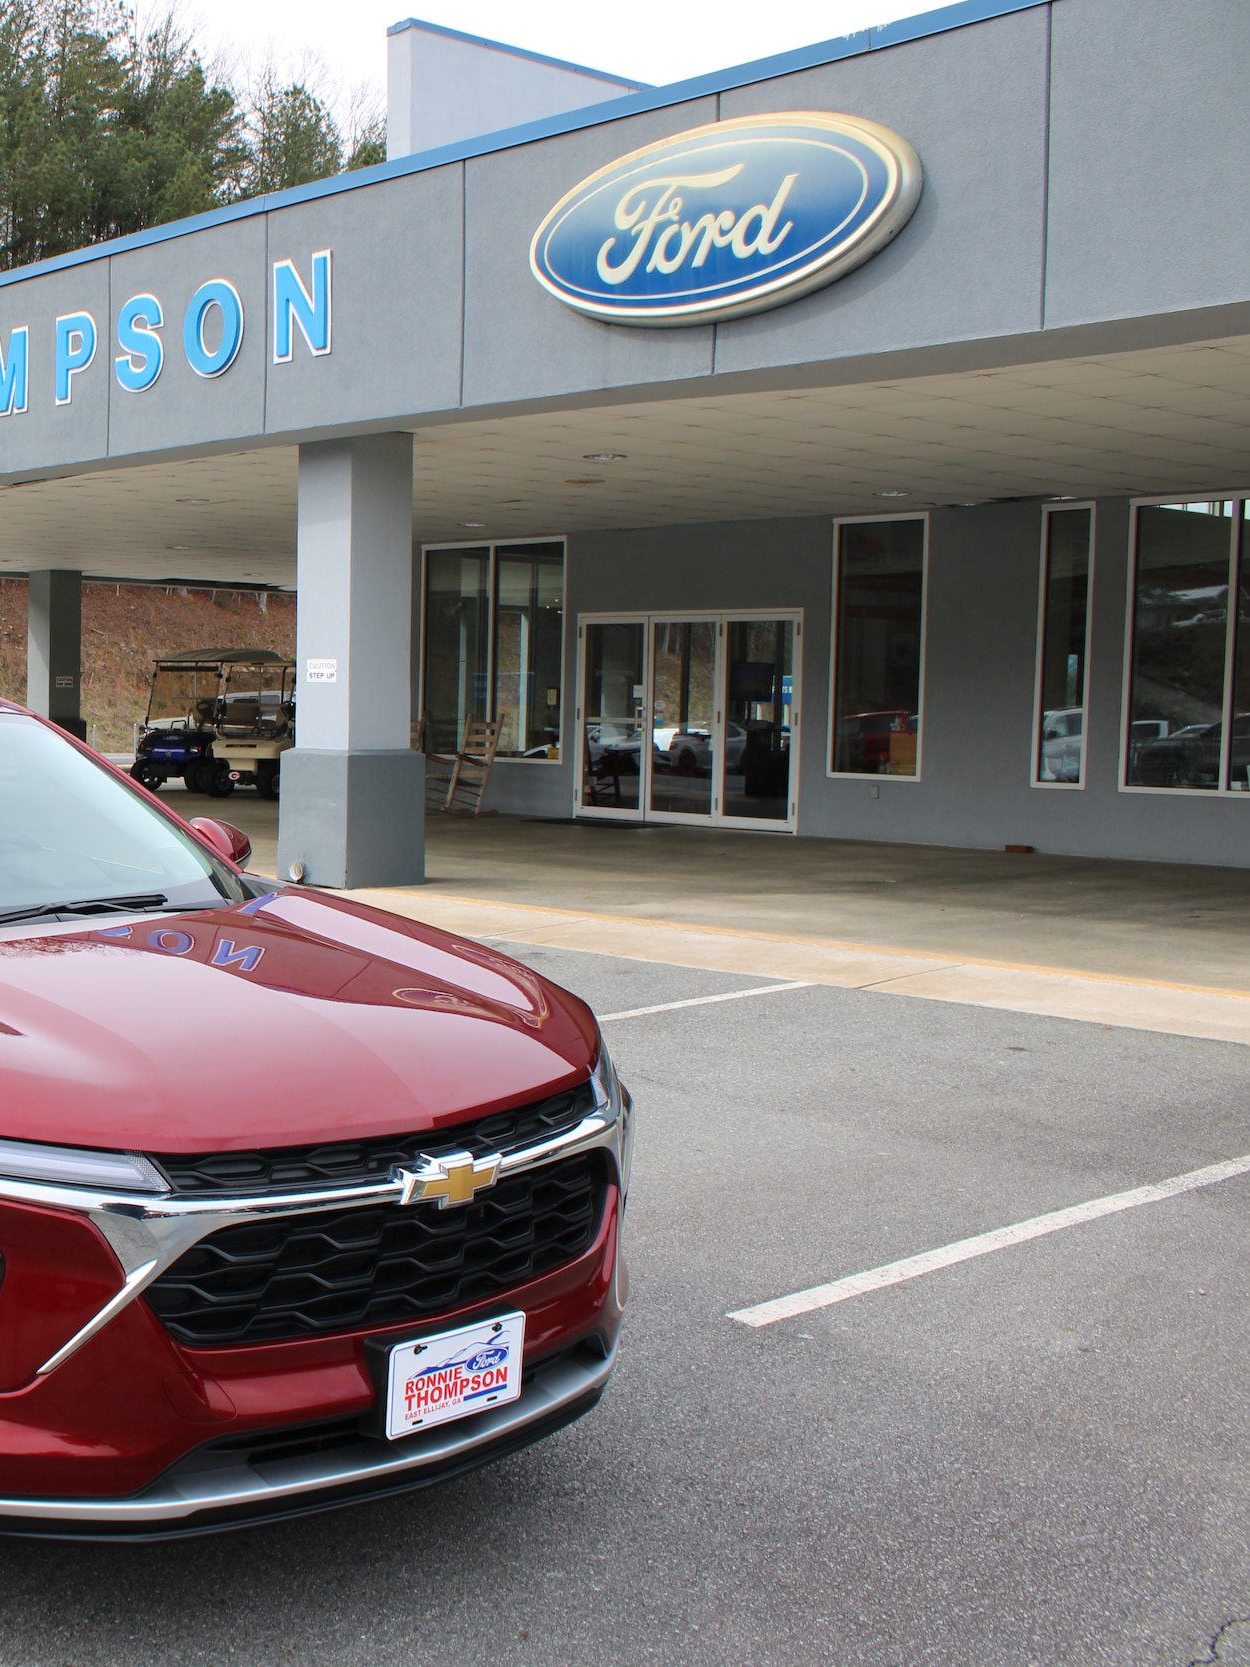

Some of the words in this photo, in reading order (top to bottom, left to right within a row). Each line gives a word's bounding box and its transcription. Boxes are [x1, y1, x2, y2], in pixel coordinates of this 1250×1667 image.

[596, 162, 800, 285] Ford
[472, 1350, 502, 1370] Ford
[404, 1366, 508, 1412] THOMPSON
[405, 1366, 463, 1396] RONNIE
[405, 1410, 422, 1420] EAST
[423, 1401, 451, 1415] ELLIJAY,
[452, 1396, 462, 1406] GA
